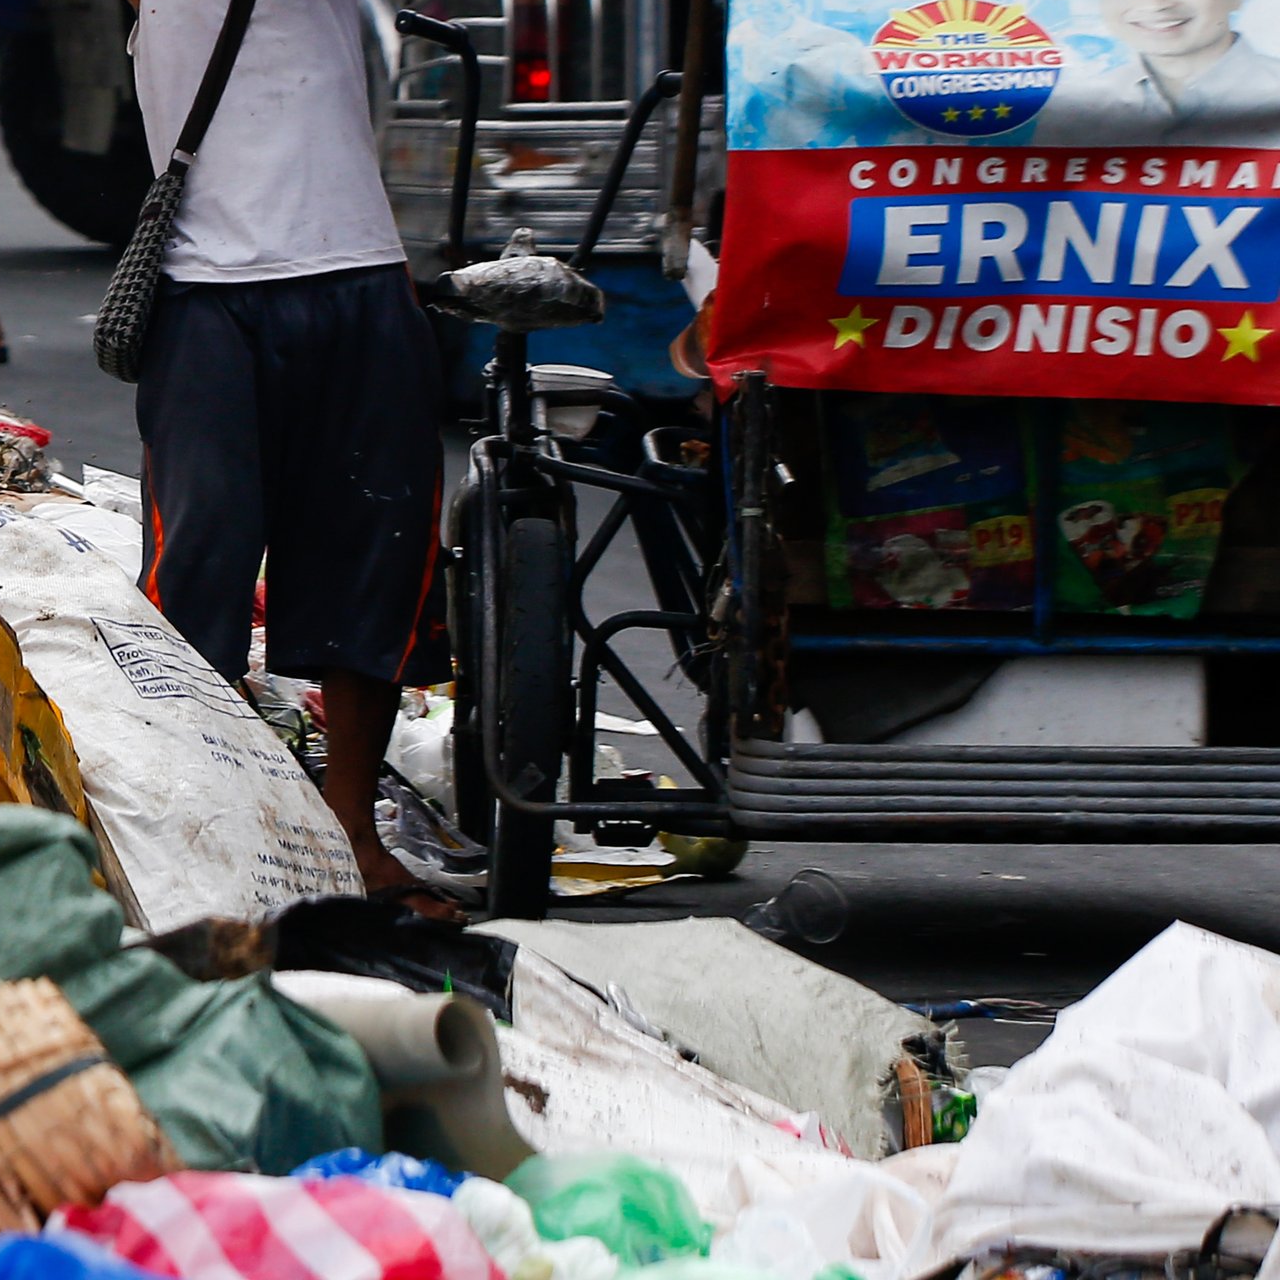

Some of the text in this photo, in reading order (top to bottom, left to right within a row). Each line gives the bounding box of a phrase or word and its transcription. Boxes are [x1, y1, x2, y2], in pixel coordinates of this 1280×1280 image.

[935, 33, 988, 45] THE
[873, 49, 1063, 70] WORKING
[890, 71, 1054, 100] CONGRESSMAN
[876, 201, 1264, 289] ERNIX
[882, 304, 1212, 359] DIONISIO
